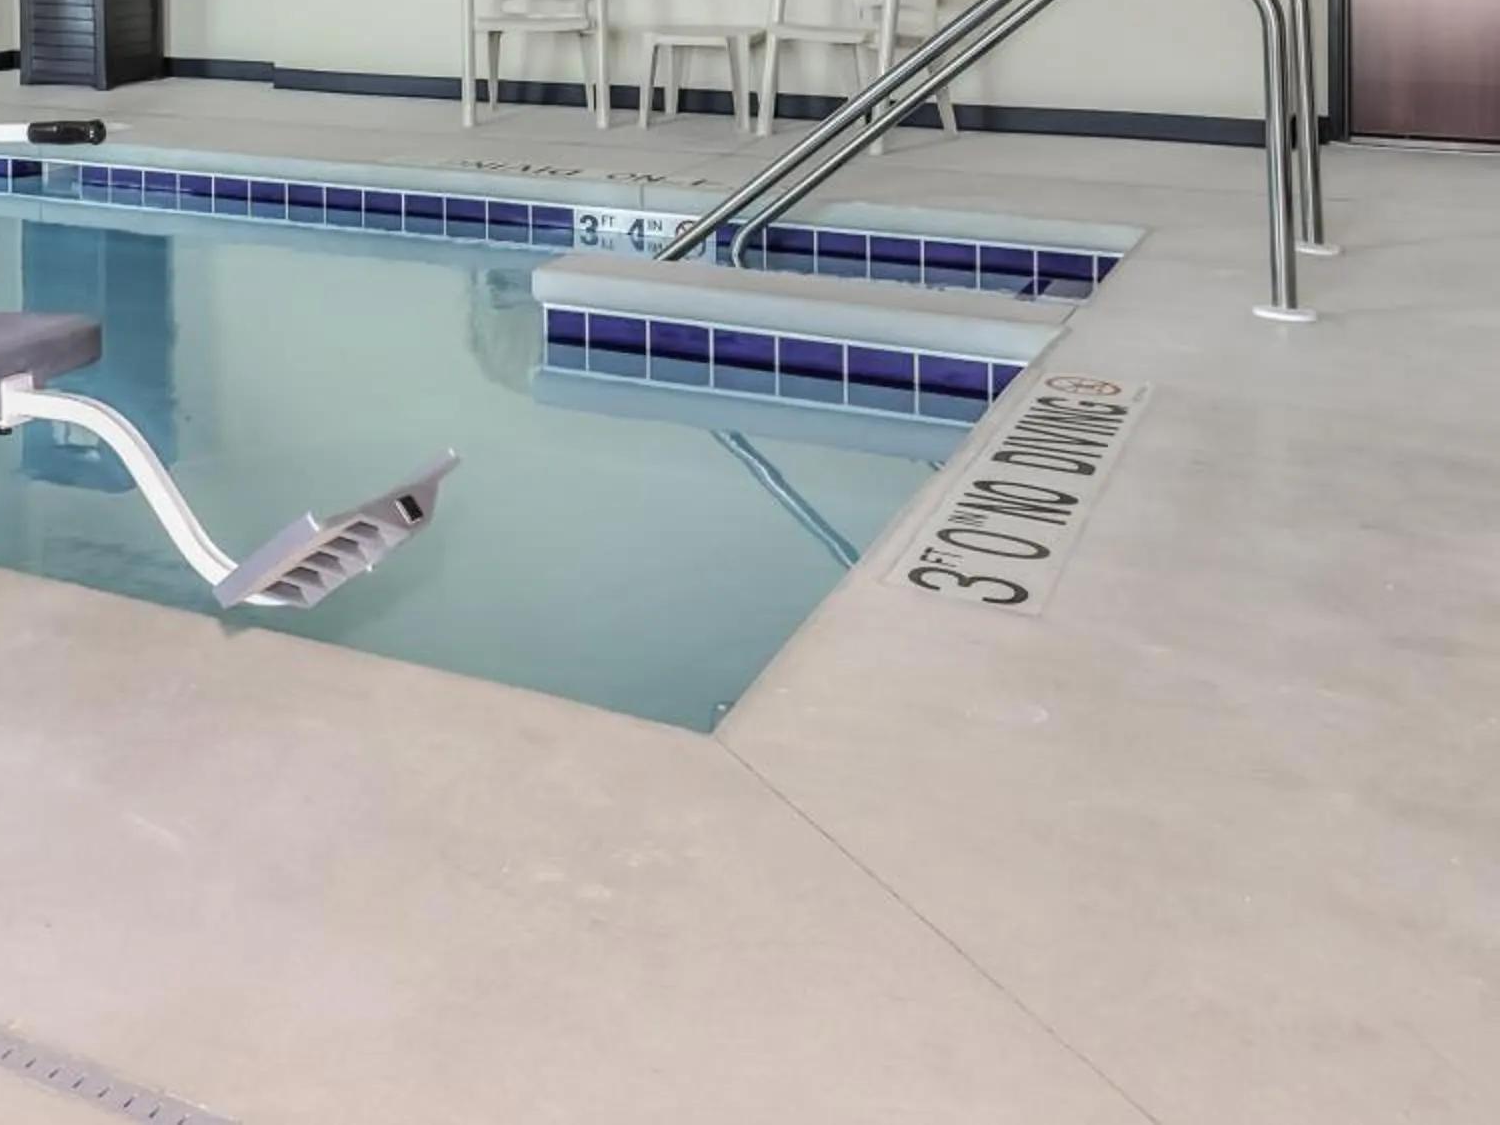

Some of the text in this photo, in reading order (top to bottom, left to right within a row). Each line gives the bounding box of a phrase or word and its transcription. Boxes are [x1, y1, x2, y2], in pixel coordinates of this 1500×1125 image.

[991, 396, 1129, 476] DIVING
[956, 480, 1080, 526] NO
[908, 566, 1029, 605] 3
